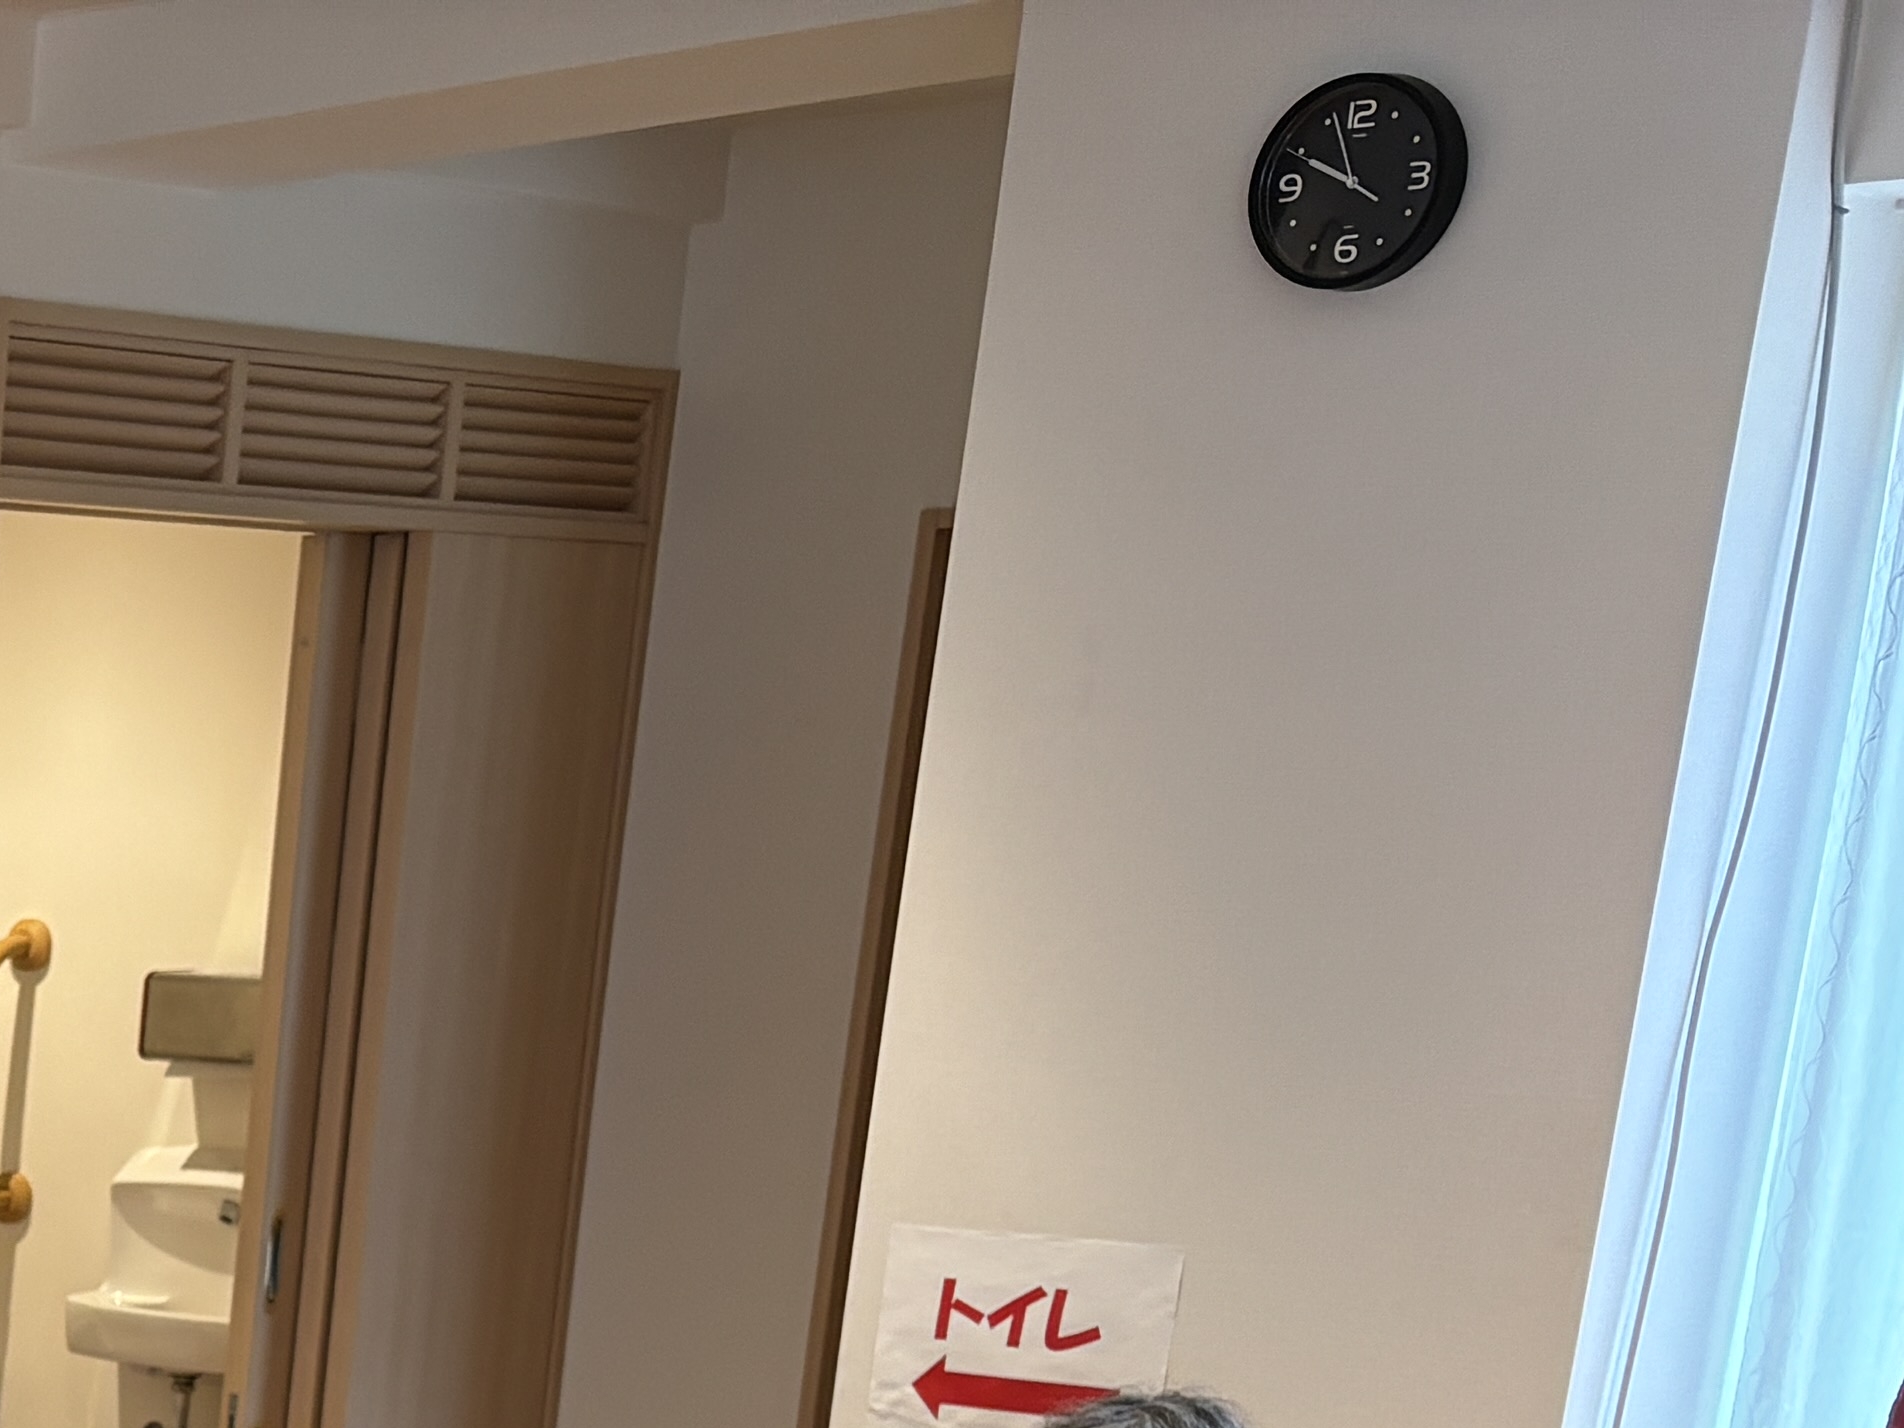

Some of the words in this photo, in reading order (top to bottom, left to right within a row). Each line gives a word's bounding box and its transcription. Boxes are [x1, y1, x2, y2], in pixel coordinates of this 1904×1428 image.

[1347, 99, 1378, 129] 12
[1278, 173, 1303, 203] 9
[1407, 161, 1431, 191] 3
[1334, 234, 1359, 263] 6
[934, 1277, 1102, 1352] トイレ
